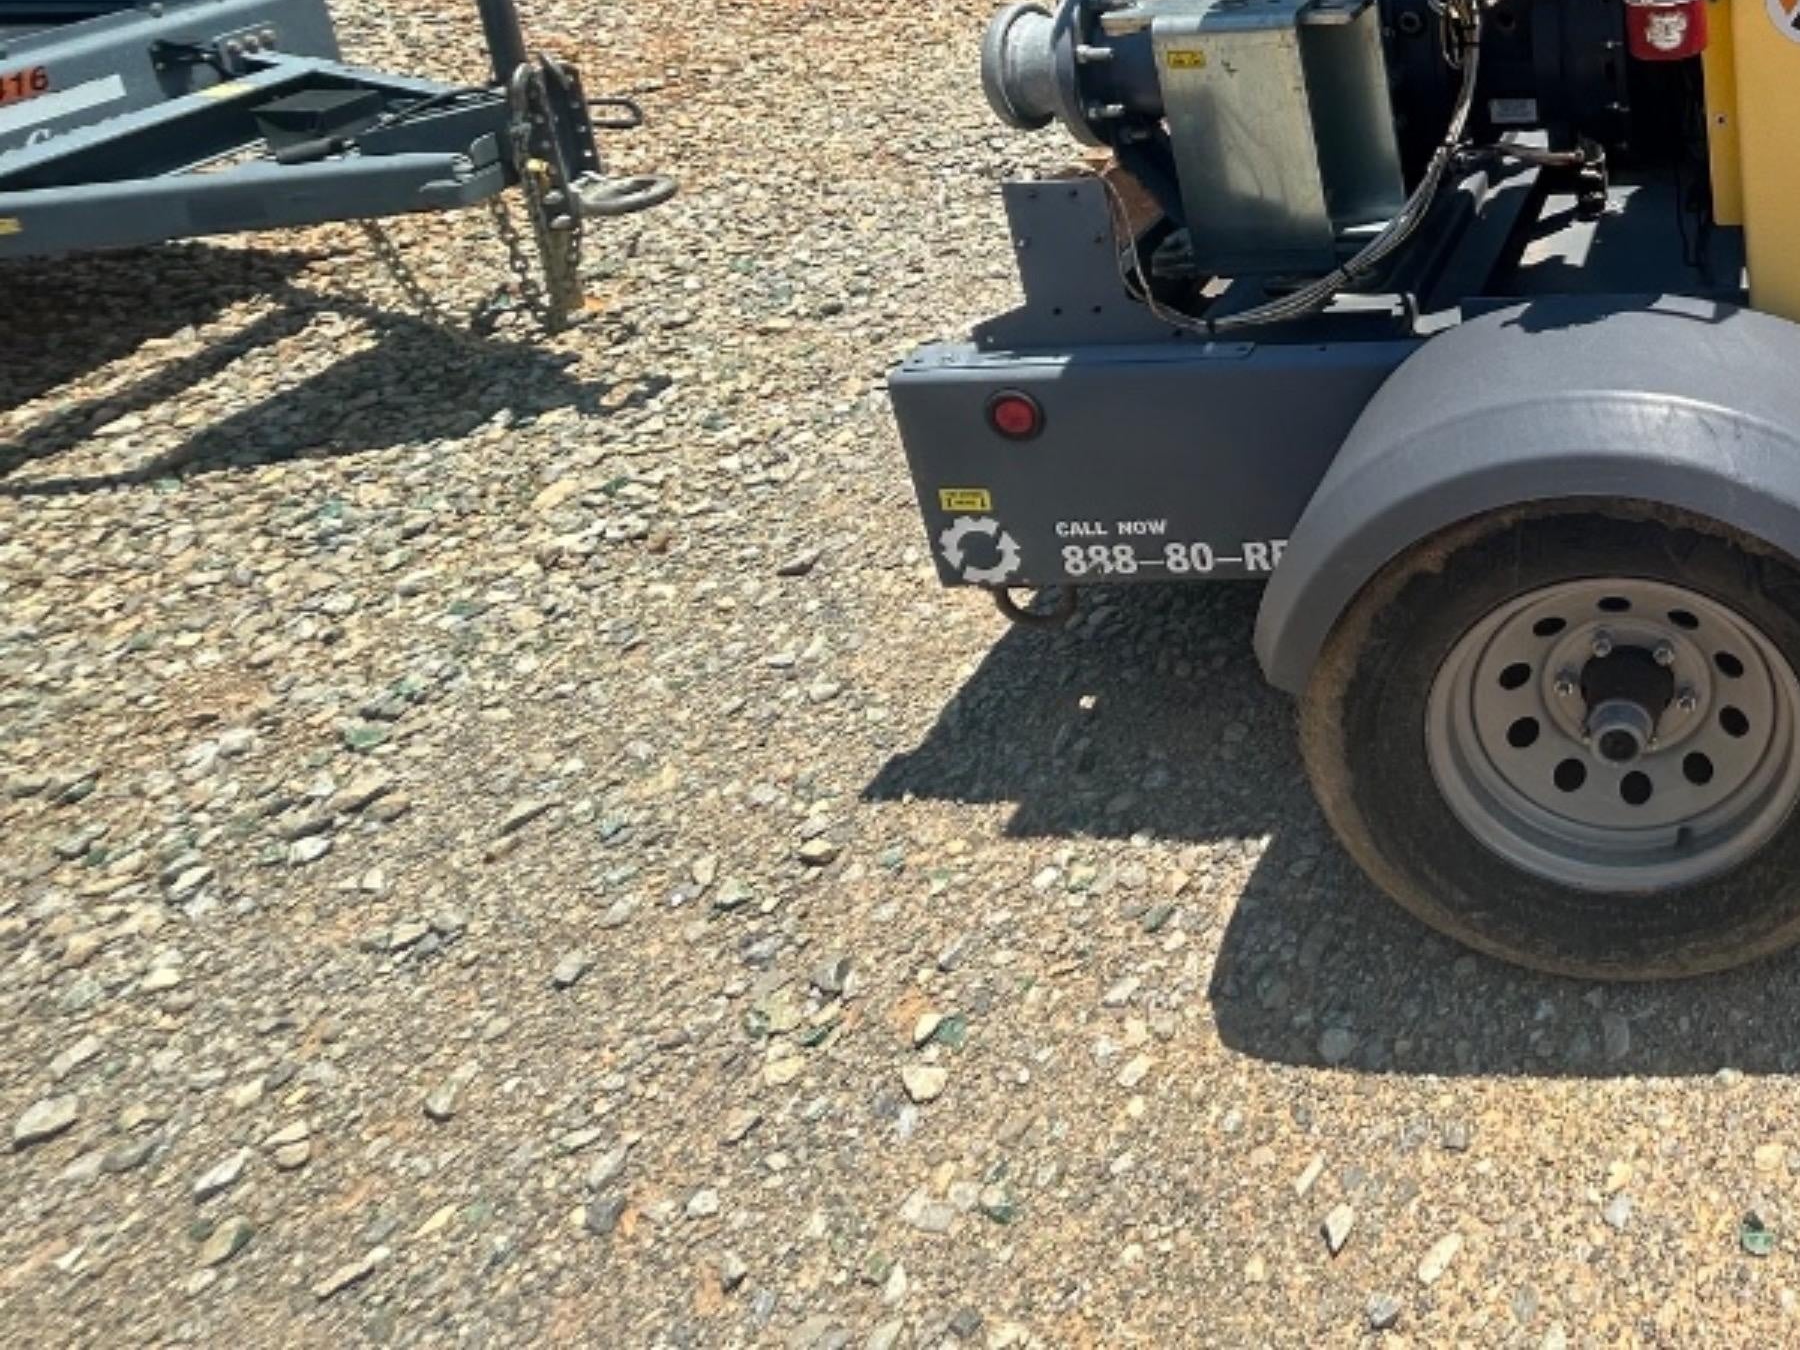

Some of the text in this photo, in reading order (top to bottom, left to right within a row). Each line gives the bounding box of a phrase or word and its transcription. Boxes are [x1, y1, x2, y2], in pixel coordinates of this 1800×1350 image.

[0, 65, 49, 102] 16
[1055, 518, 1168, 538] CALL NOW
